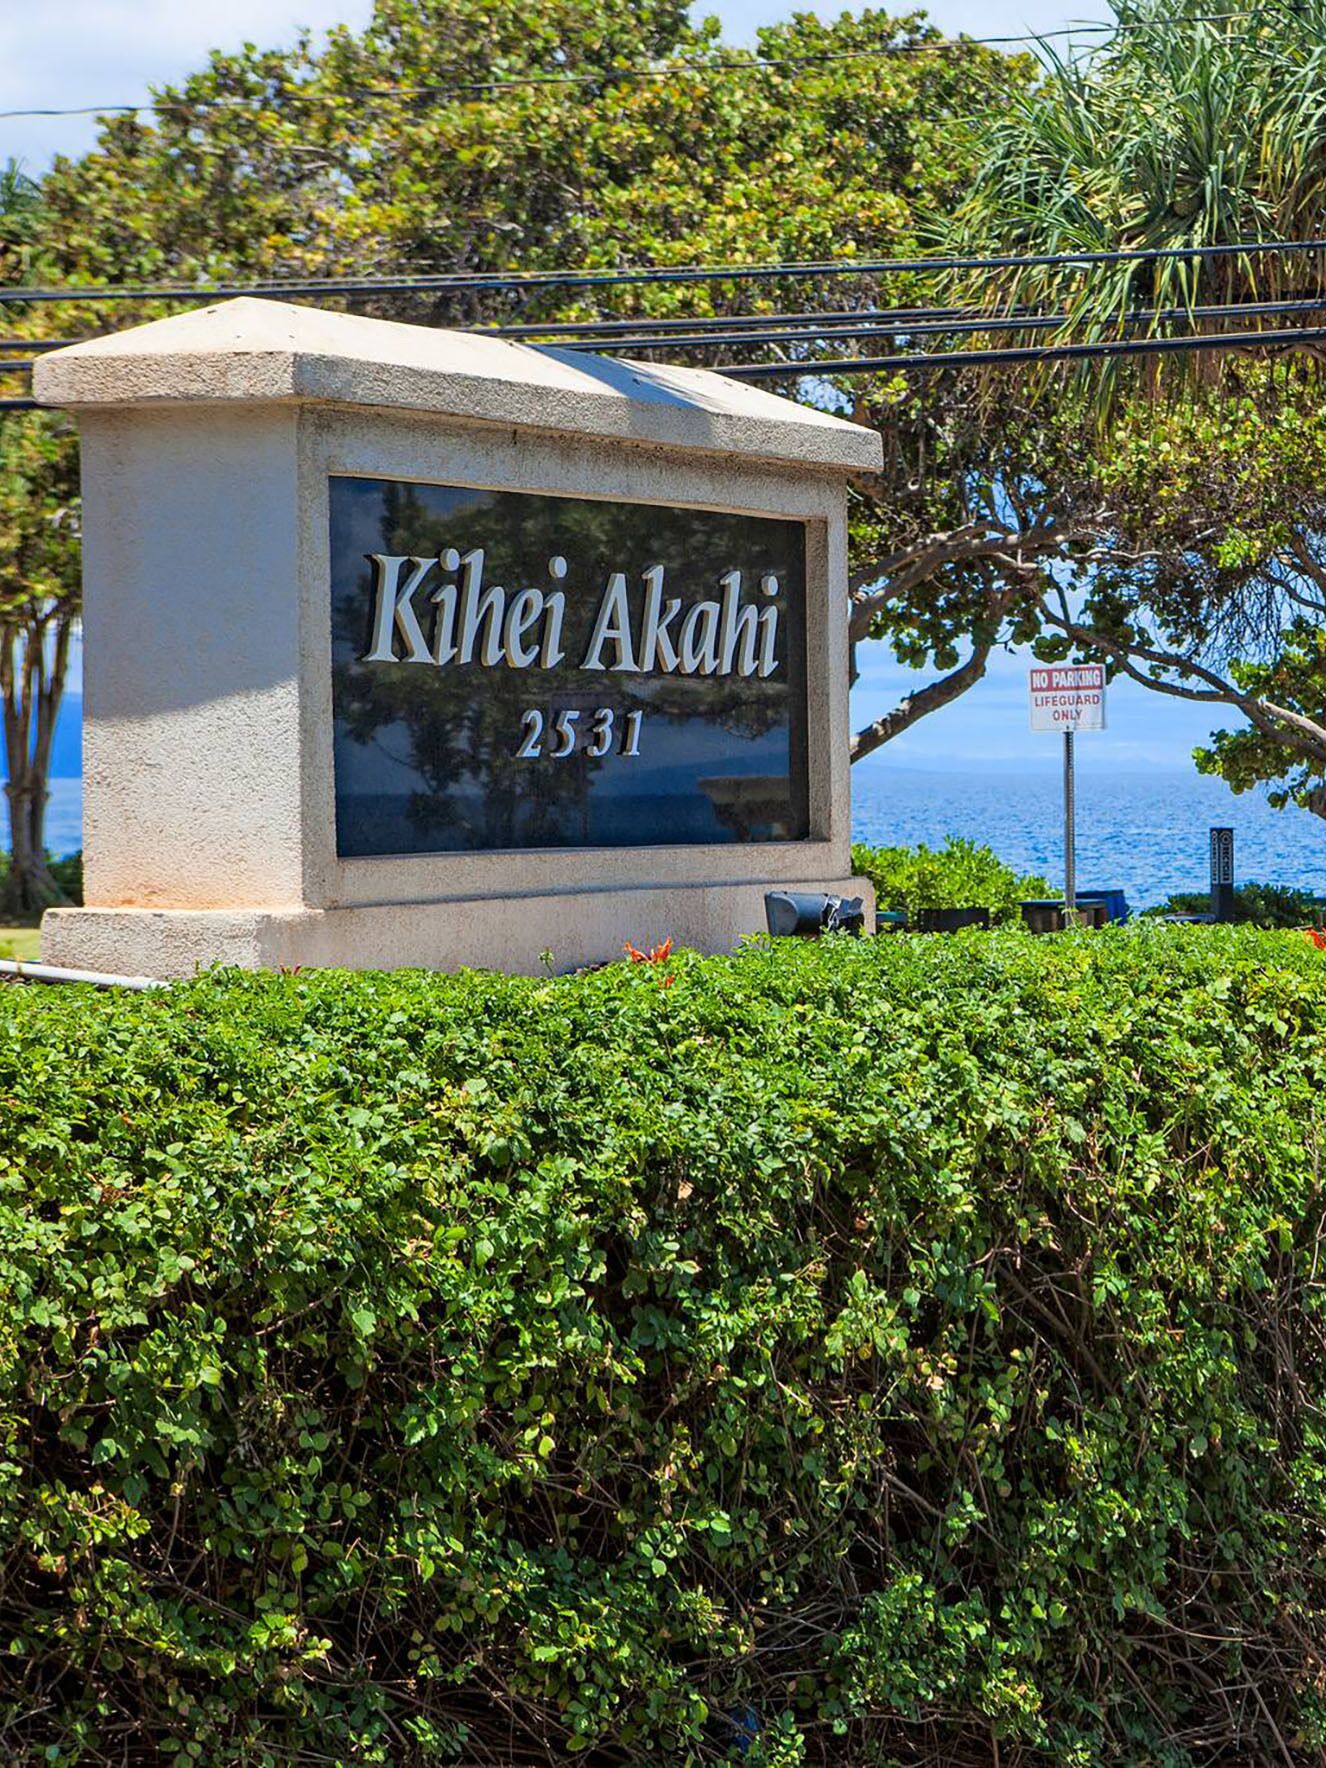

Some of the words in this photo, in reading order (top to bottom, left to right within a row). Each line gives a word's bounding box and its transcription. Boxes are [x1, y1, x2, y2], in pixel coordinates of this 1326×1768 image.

[361, 548, 567, 669] Kihei
[579, 564, 780, 678] Akahi
[1032, 671, 1049, 688] NO
[1052, 670, 1101, 688] PARKING
[1034, 694, 1100, 707] LIFEGUARD
[1052, 709, 1082, 721] ONLY
[515, 708, 643, 758] 2531
